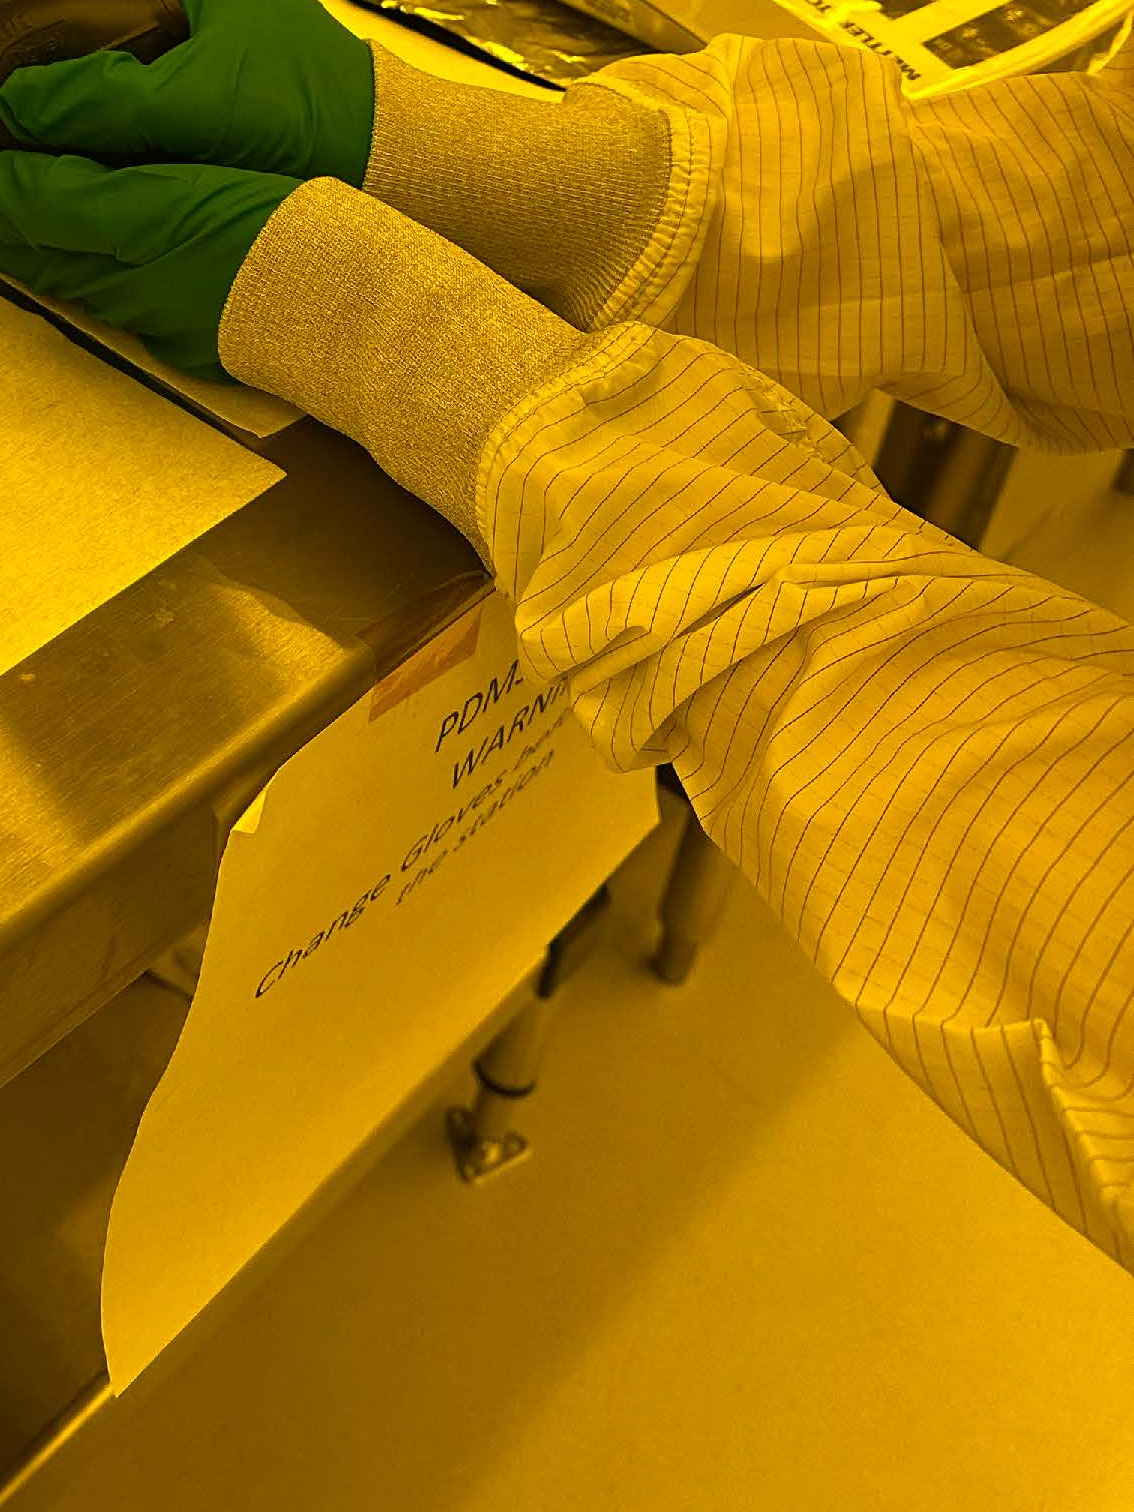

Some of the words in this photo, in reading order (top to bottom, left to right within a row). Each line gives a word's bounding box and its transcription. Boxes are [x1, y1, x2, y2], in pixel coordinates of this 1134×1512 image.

[435, 659, 524, 752] PDM
[255, 873, 391, 999] Change
[400, 768, 509, 872] Gloves
